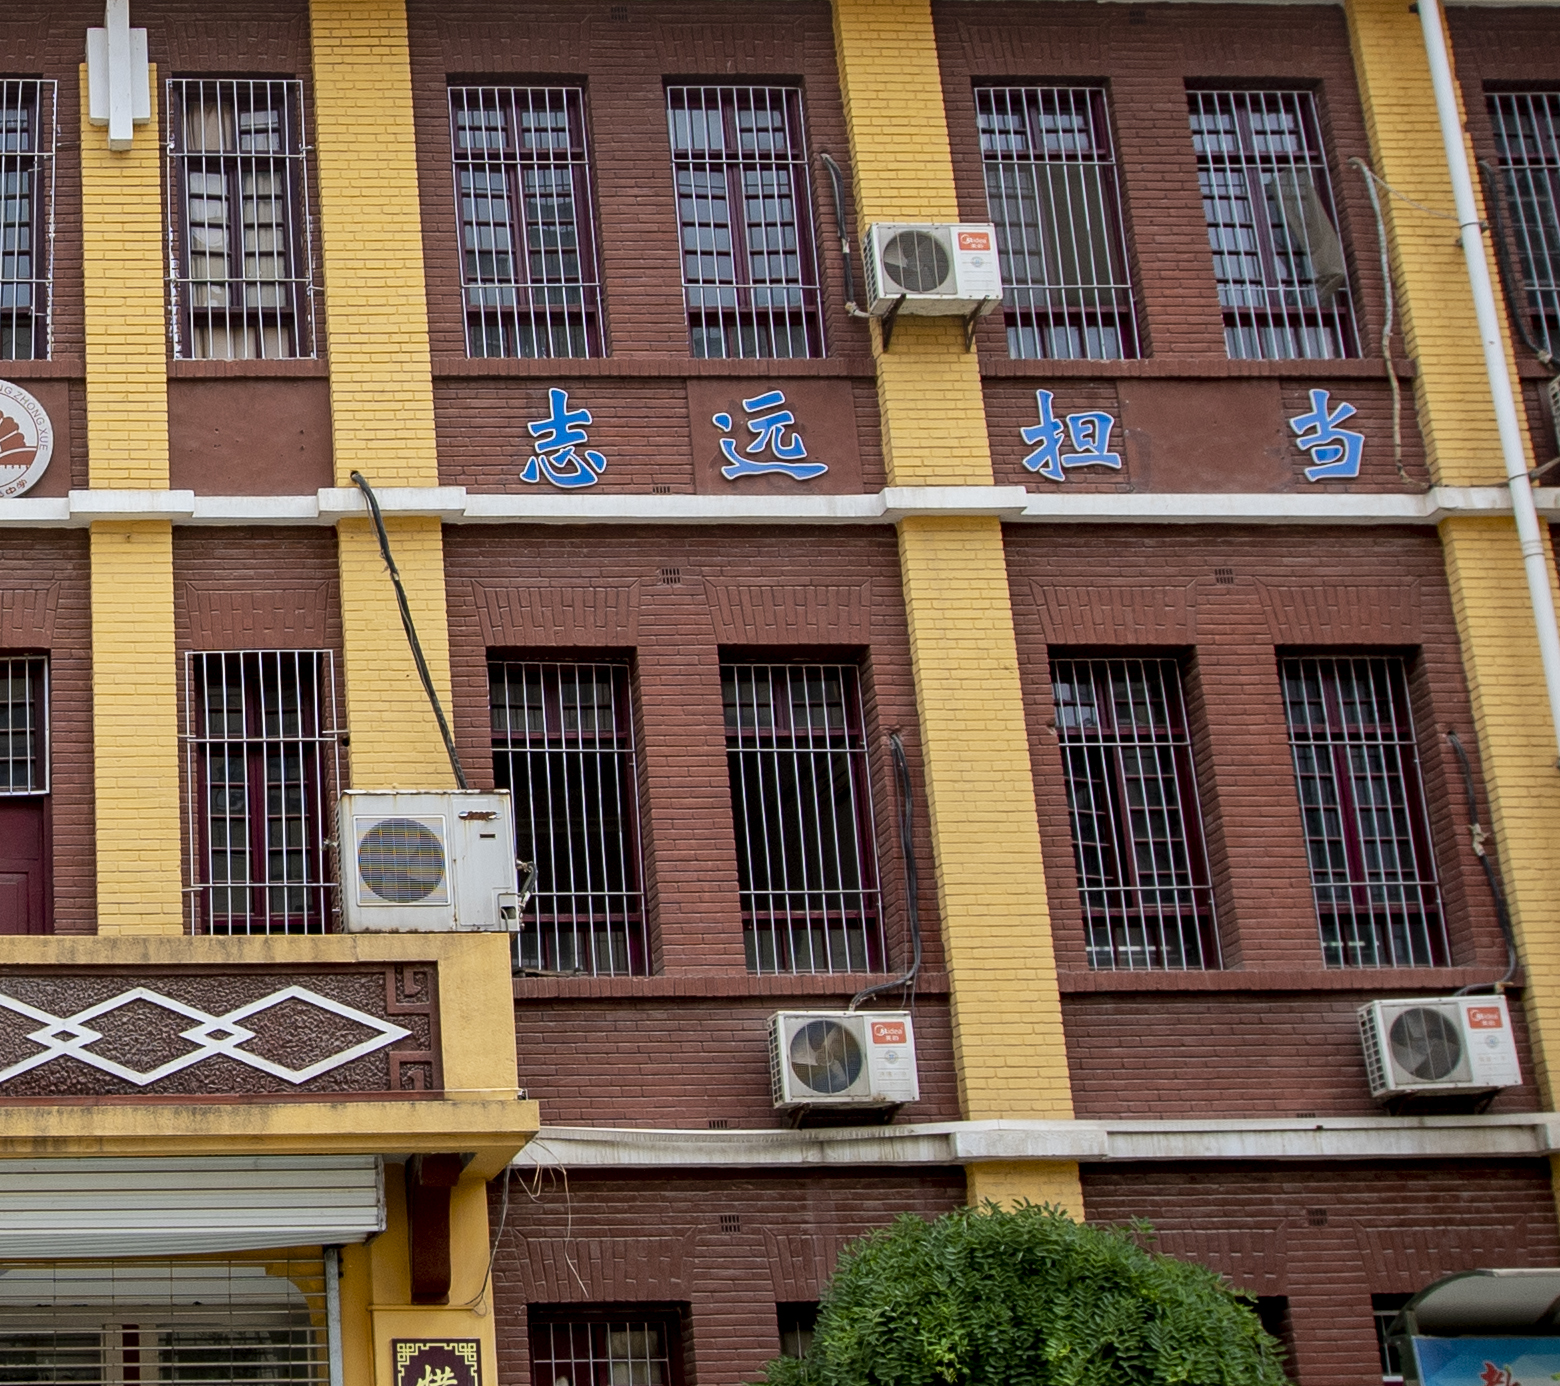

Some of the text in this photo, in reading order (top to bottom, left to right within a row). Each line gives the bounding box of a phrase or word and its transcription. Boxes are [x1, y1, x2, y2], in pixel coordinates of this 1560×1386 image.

[13, 390, 45, 426] ZHONG
[38, 427, 49, 451] XUE
[518, 387, 1366, 489] 志远担当
